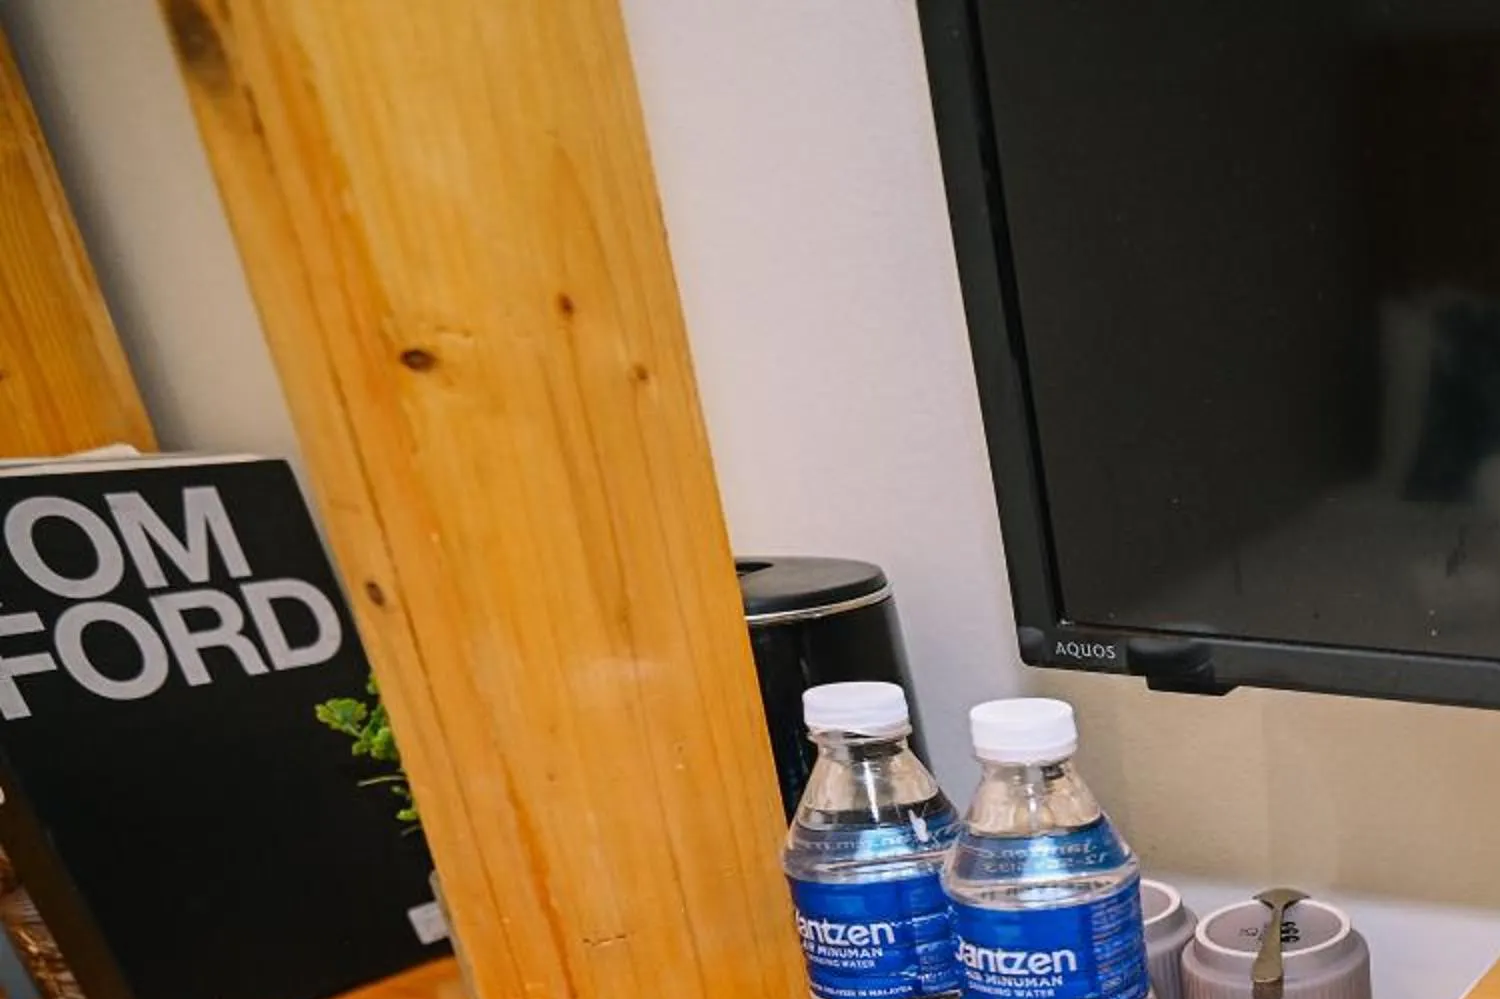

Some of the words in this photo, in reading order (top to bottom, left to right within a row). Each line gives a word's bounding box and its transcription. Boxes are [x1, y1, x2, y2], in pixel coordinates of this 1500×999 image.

[0, 576, 343, 722] FORD
[1055, 640, 1117, 660] AQUOS
[985, 973, 1063, 987] MINUMAN
[1014, 988, 1056, 999] WATER
